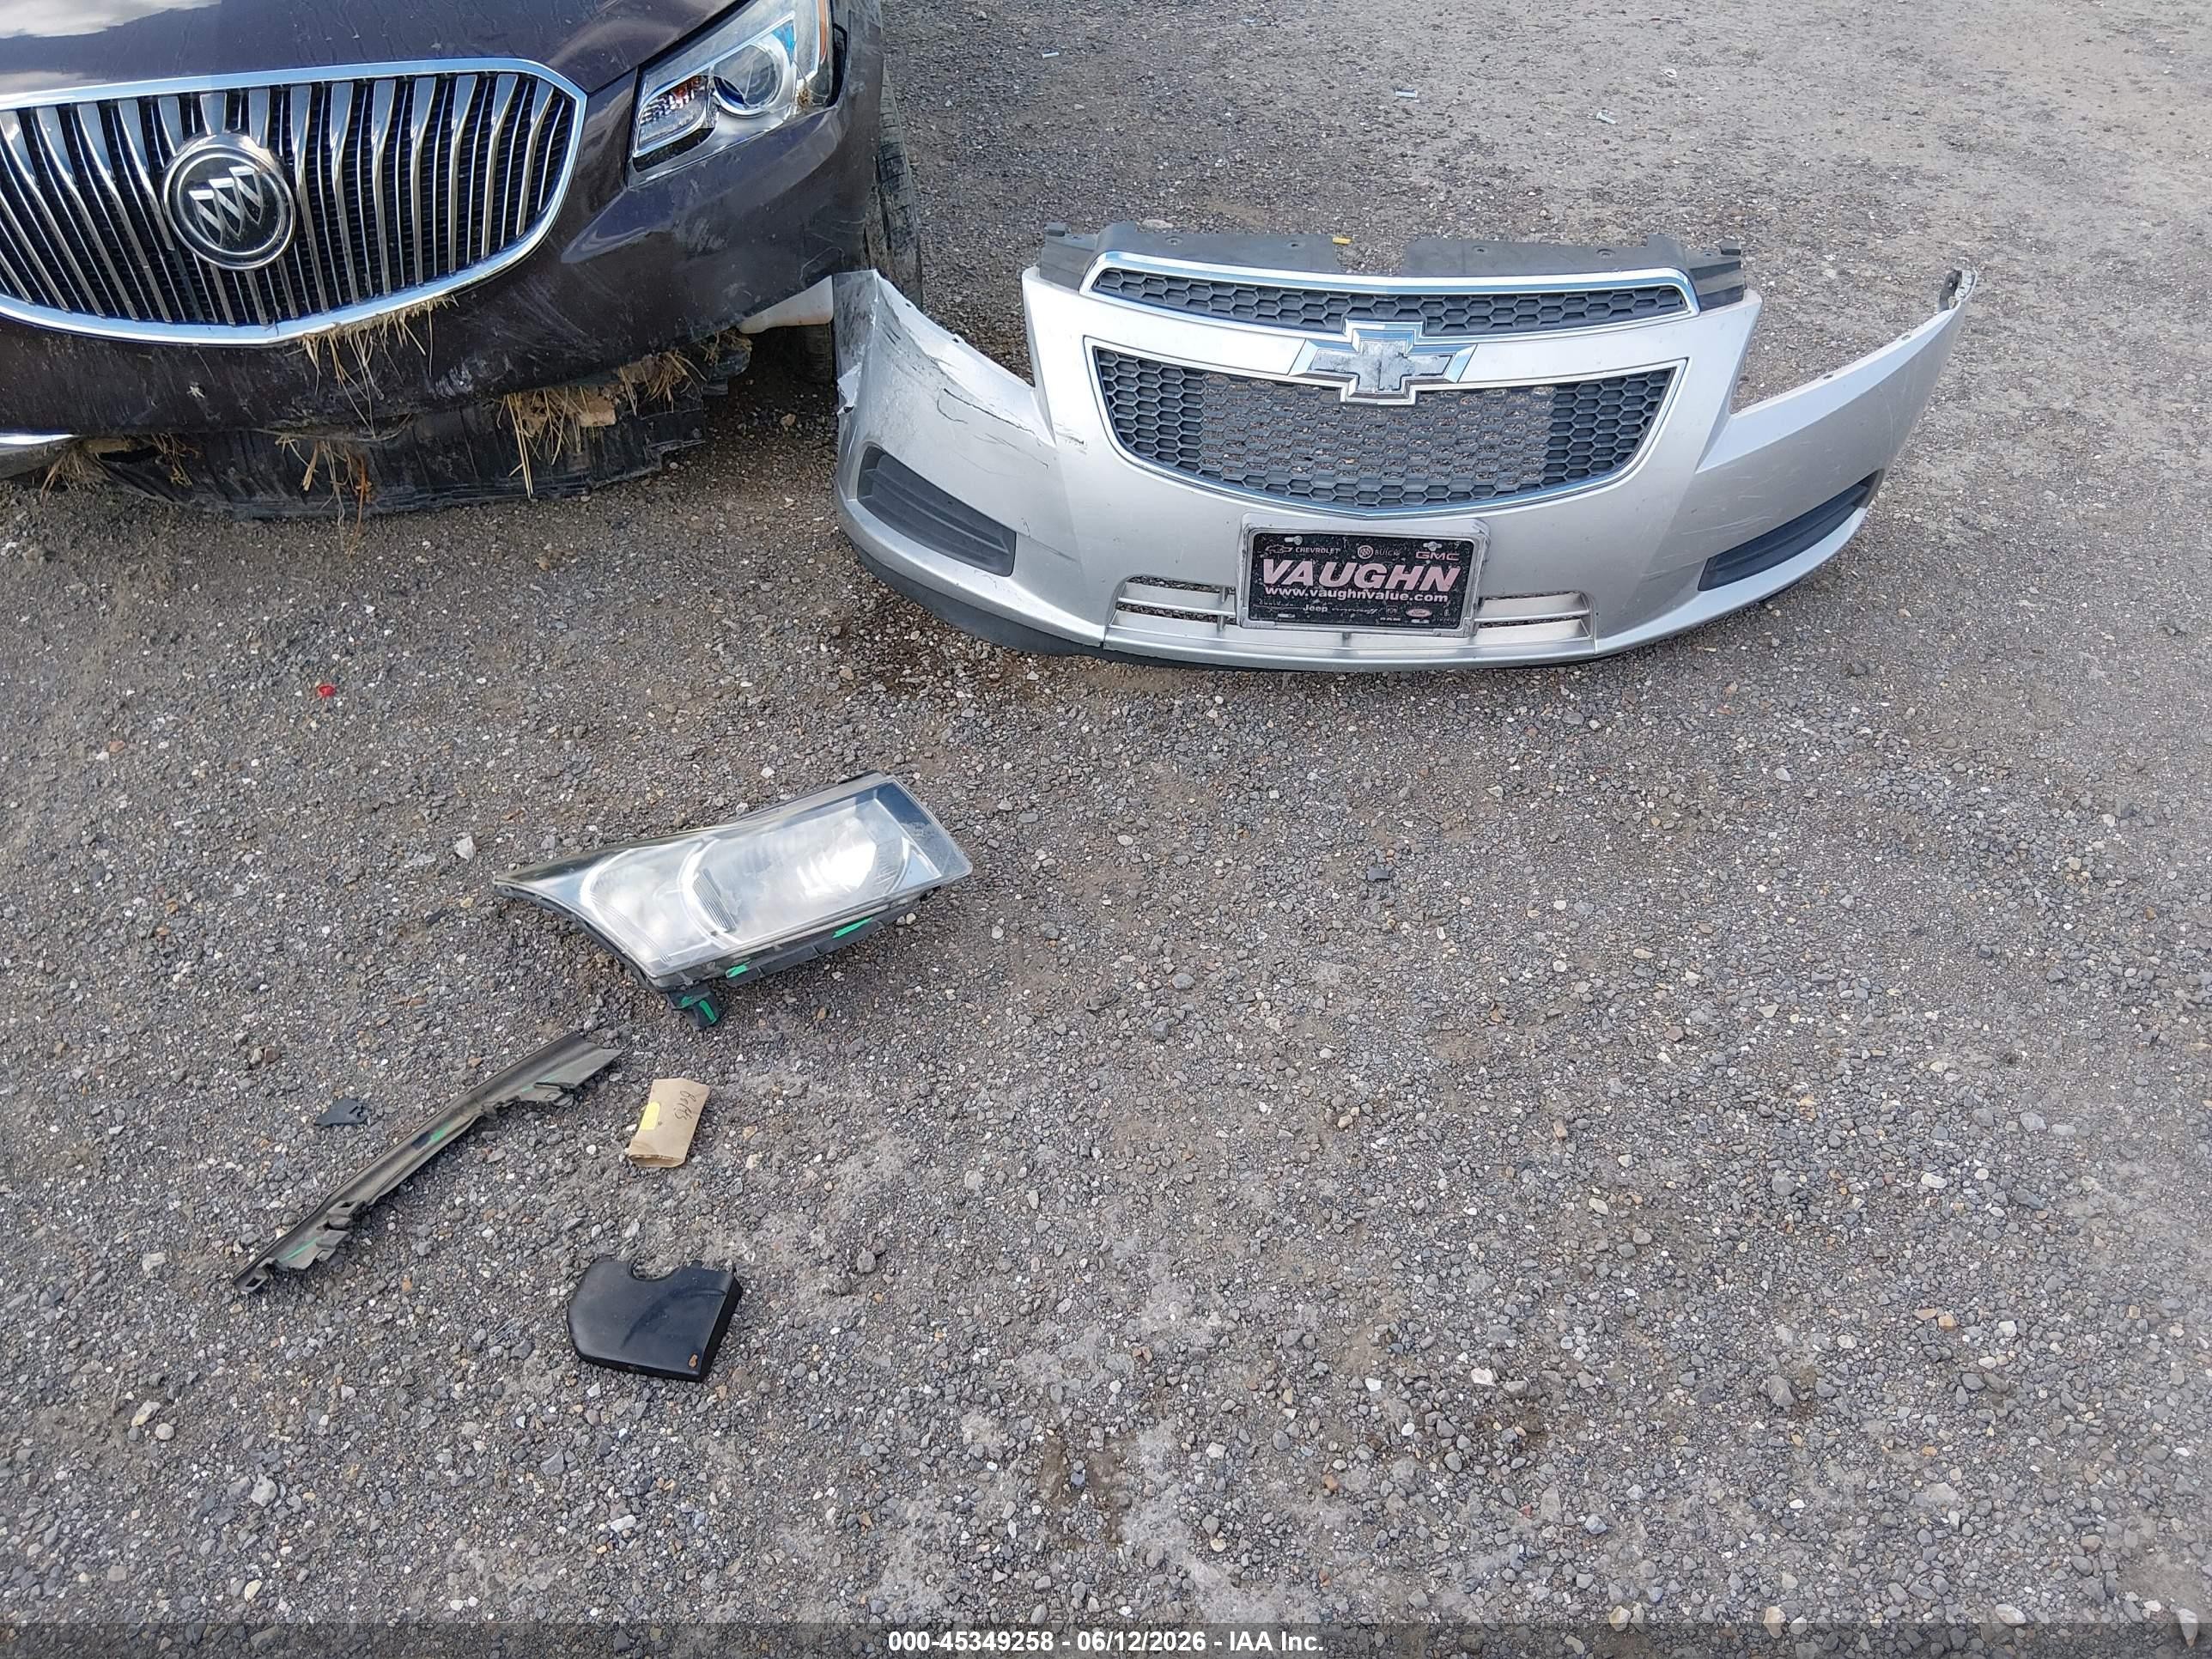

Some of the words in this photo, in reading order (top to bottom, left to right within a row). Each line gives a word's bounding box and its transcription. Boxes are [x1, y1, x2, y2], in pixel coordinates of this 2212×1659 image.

[1295, 546, 1340, 555] CHEVROLET
[1375, 548, 1400, 556] BUICK
[1415, 550, 1460, 561] GMC
[1263, 558, 1461, 592] VAUGHN
[1265, 586, 1449, 603] www.vaughnvalue.com
[1303, 604, 1328, 612] Jeep
